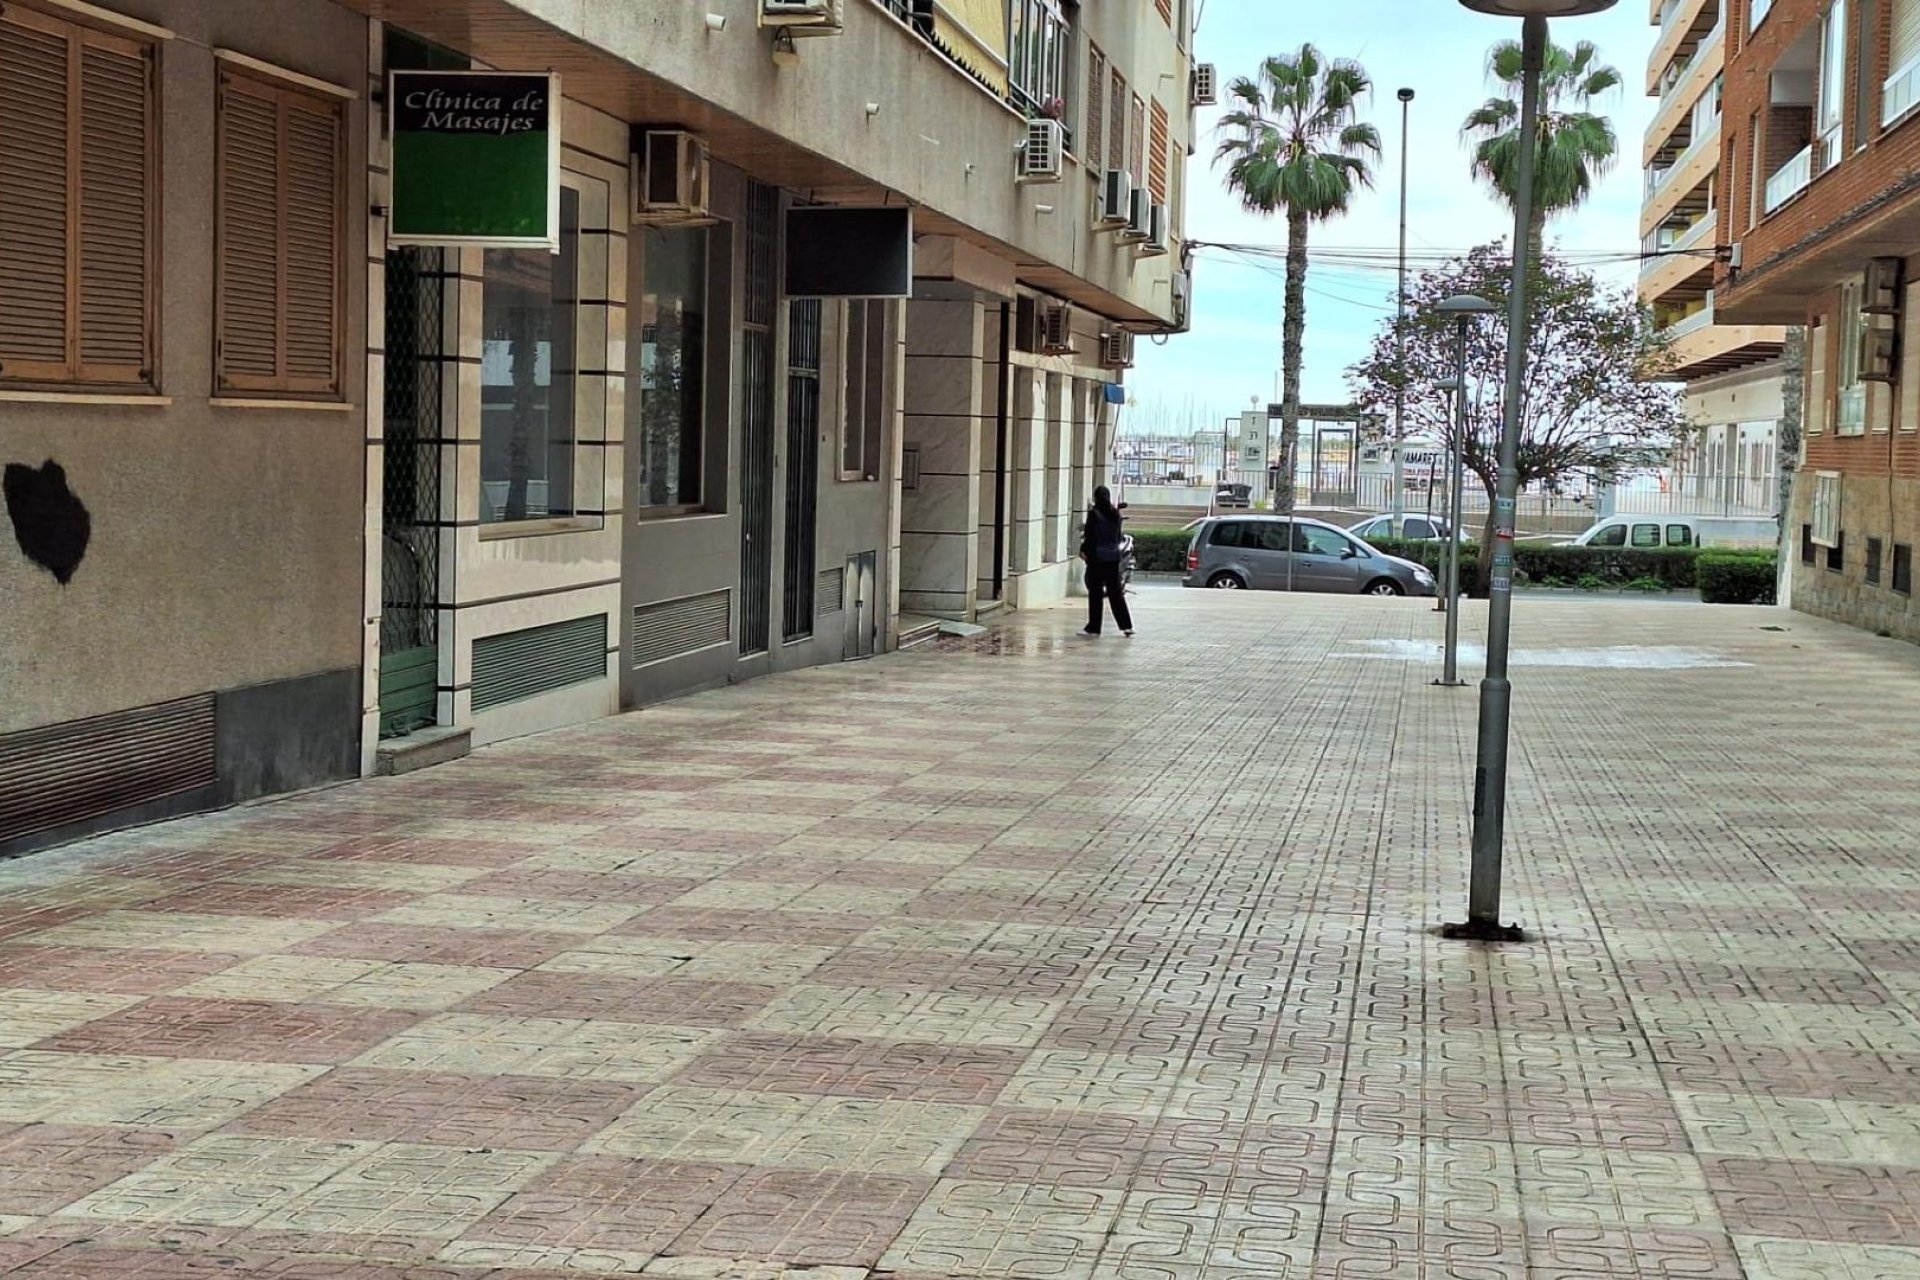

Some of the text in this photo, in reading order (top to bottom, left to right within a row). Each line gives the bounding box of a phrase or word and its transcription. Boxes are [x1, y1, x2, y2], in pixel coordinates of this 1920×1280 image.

[405, 89, 544, 111] Clínica de
[421, 111, 535, 135] Masajes
